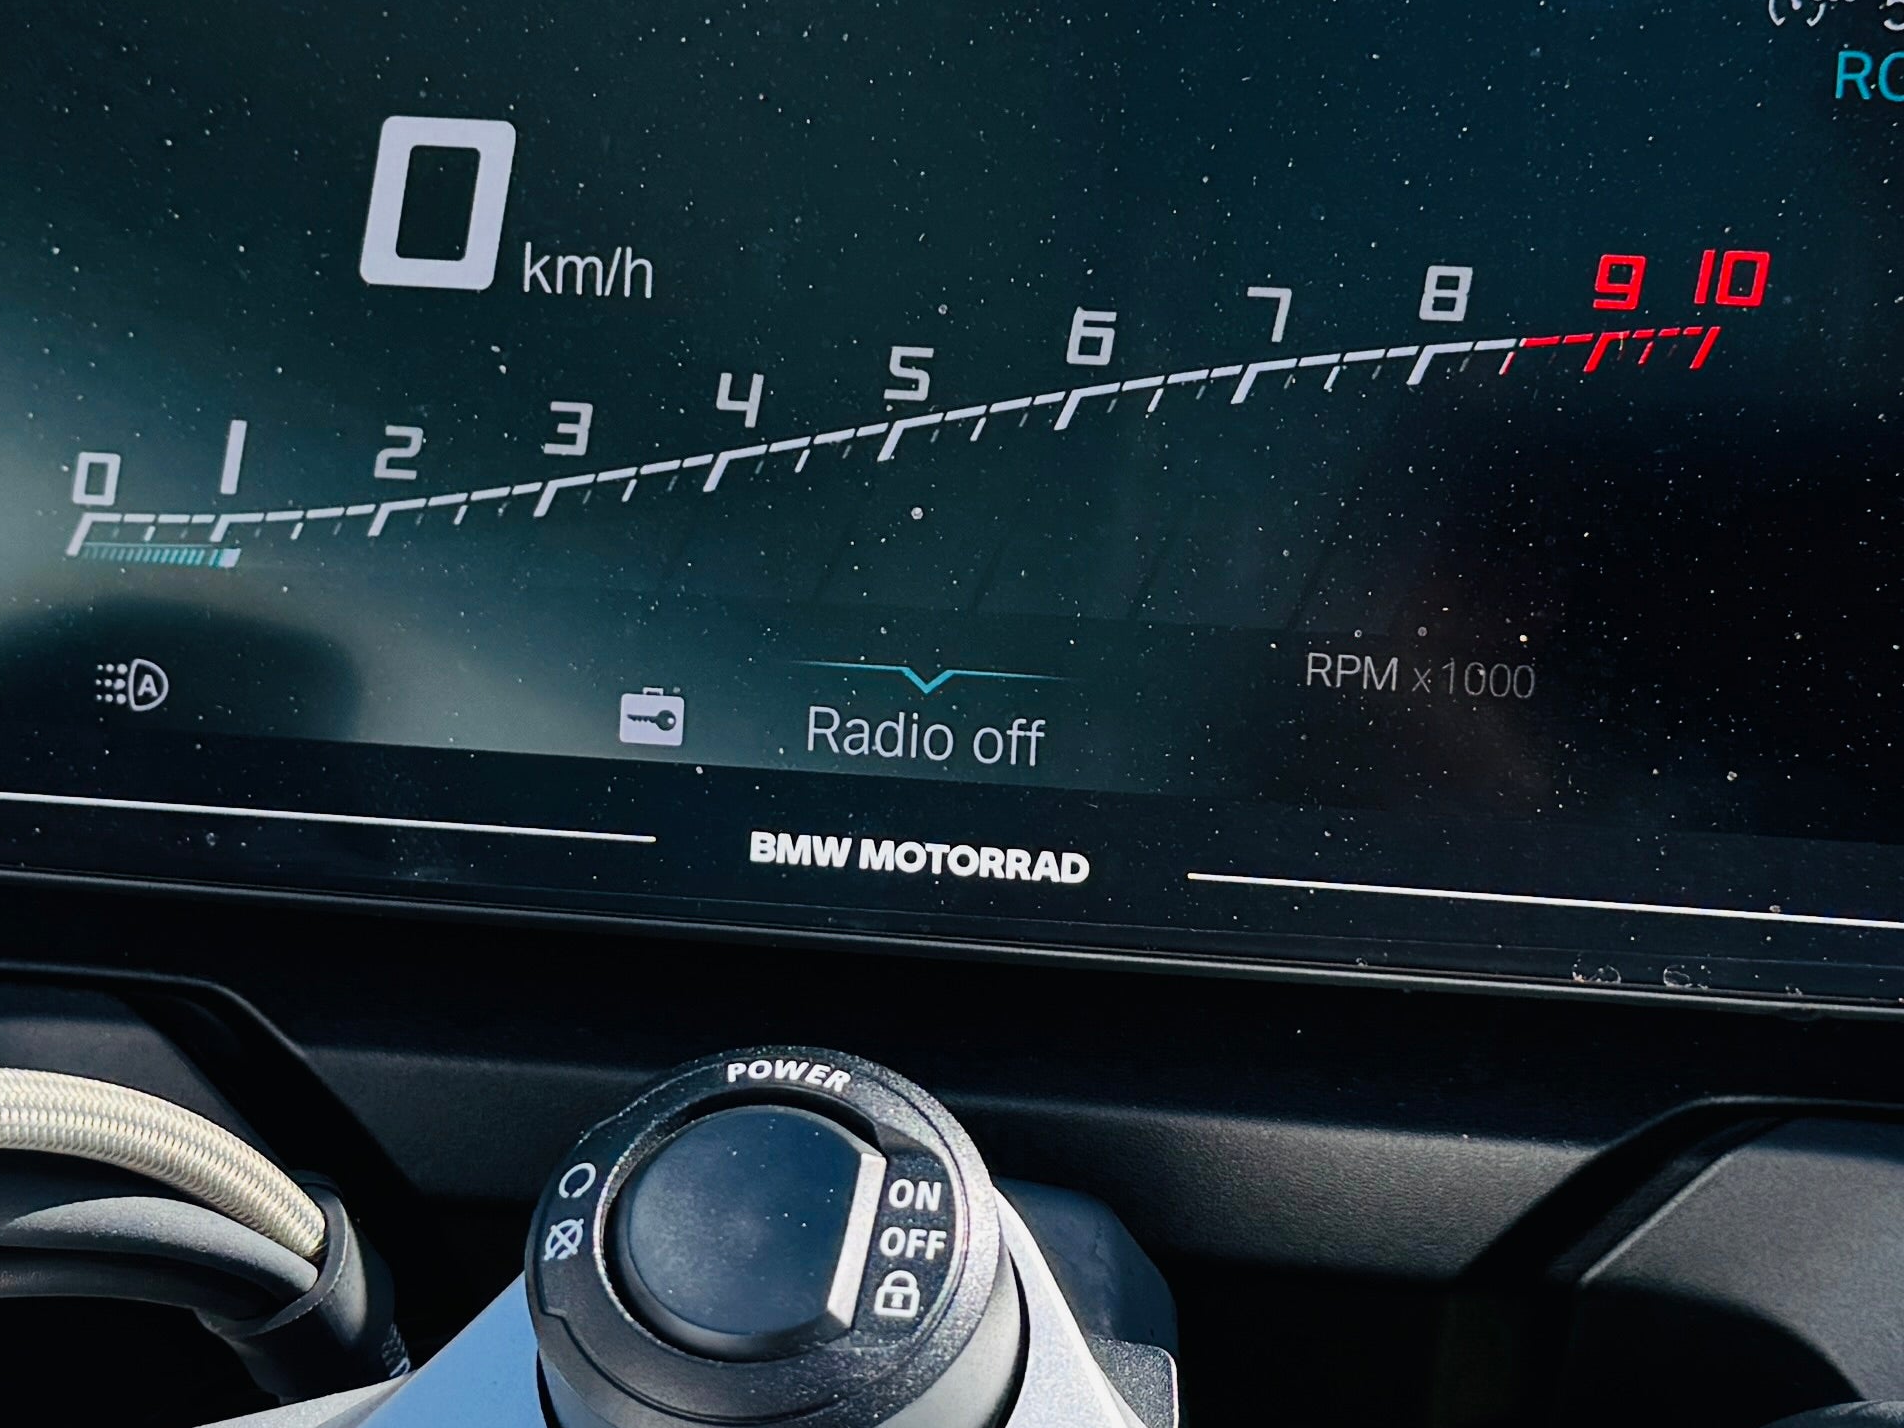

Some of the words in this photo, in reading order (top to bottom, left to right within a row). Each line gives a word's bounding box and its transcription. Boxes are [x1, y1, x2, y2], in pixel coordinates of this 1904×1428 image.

[360, 115, 516, 291] 0
[523, 241, 653, 299] km/h
[72, 452, 121, 506] 0
[220, 419, 247, 495] 1
[374, 425, 425, 480] 2
[543, 401, 594, 456] 3
[716, 372, 764, 428] 4
[884, 346, 935, 401] 5
[1066, 307, 1116, 365] 6
[1247, 286, 1292, 342] 7
[1419, 265, 1473, 322] 8
[1593, 254, 1646, 310] 9
[1694, 249, 1771, 307] 10
[1306, 652, 1398, 692] RPM
[807, 705, 954, 762] Radio
[973, 718, 1046, 767] off
[749, 830, 853, 869] BMW
[858, 838, 1090, 884] MOTORRAD
[727, 1059, 851, 1093] POWER
[888, 1178, 942, 1212] ON
[879, 1226, 947, 1260] OFF
